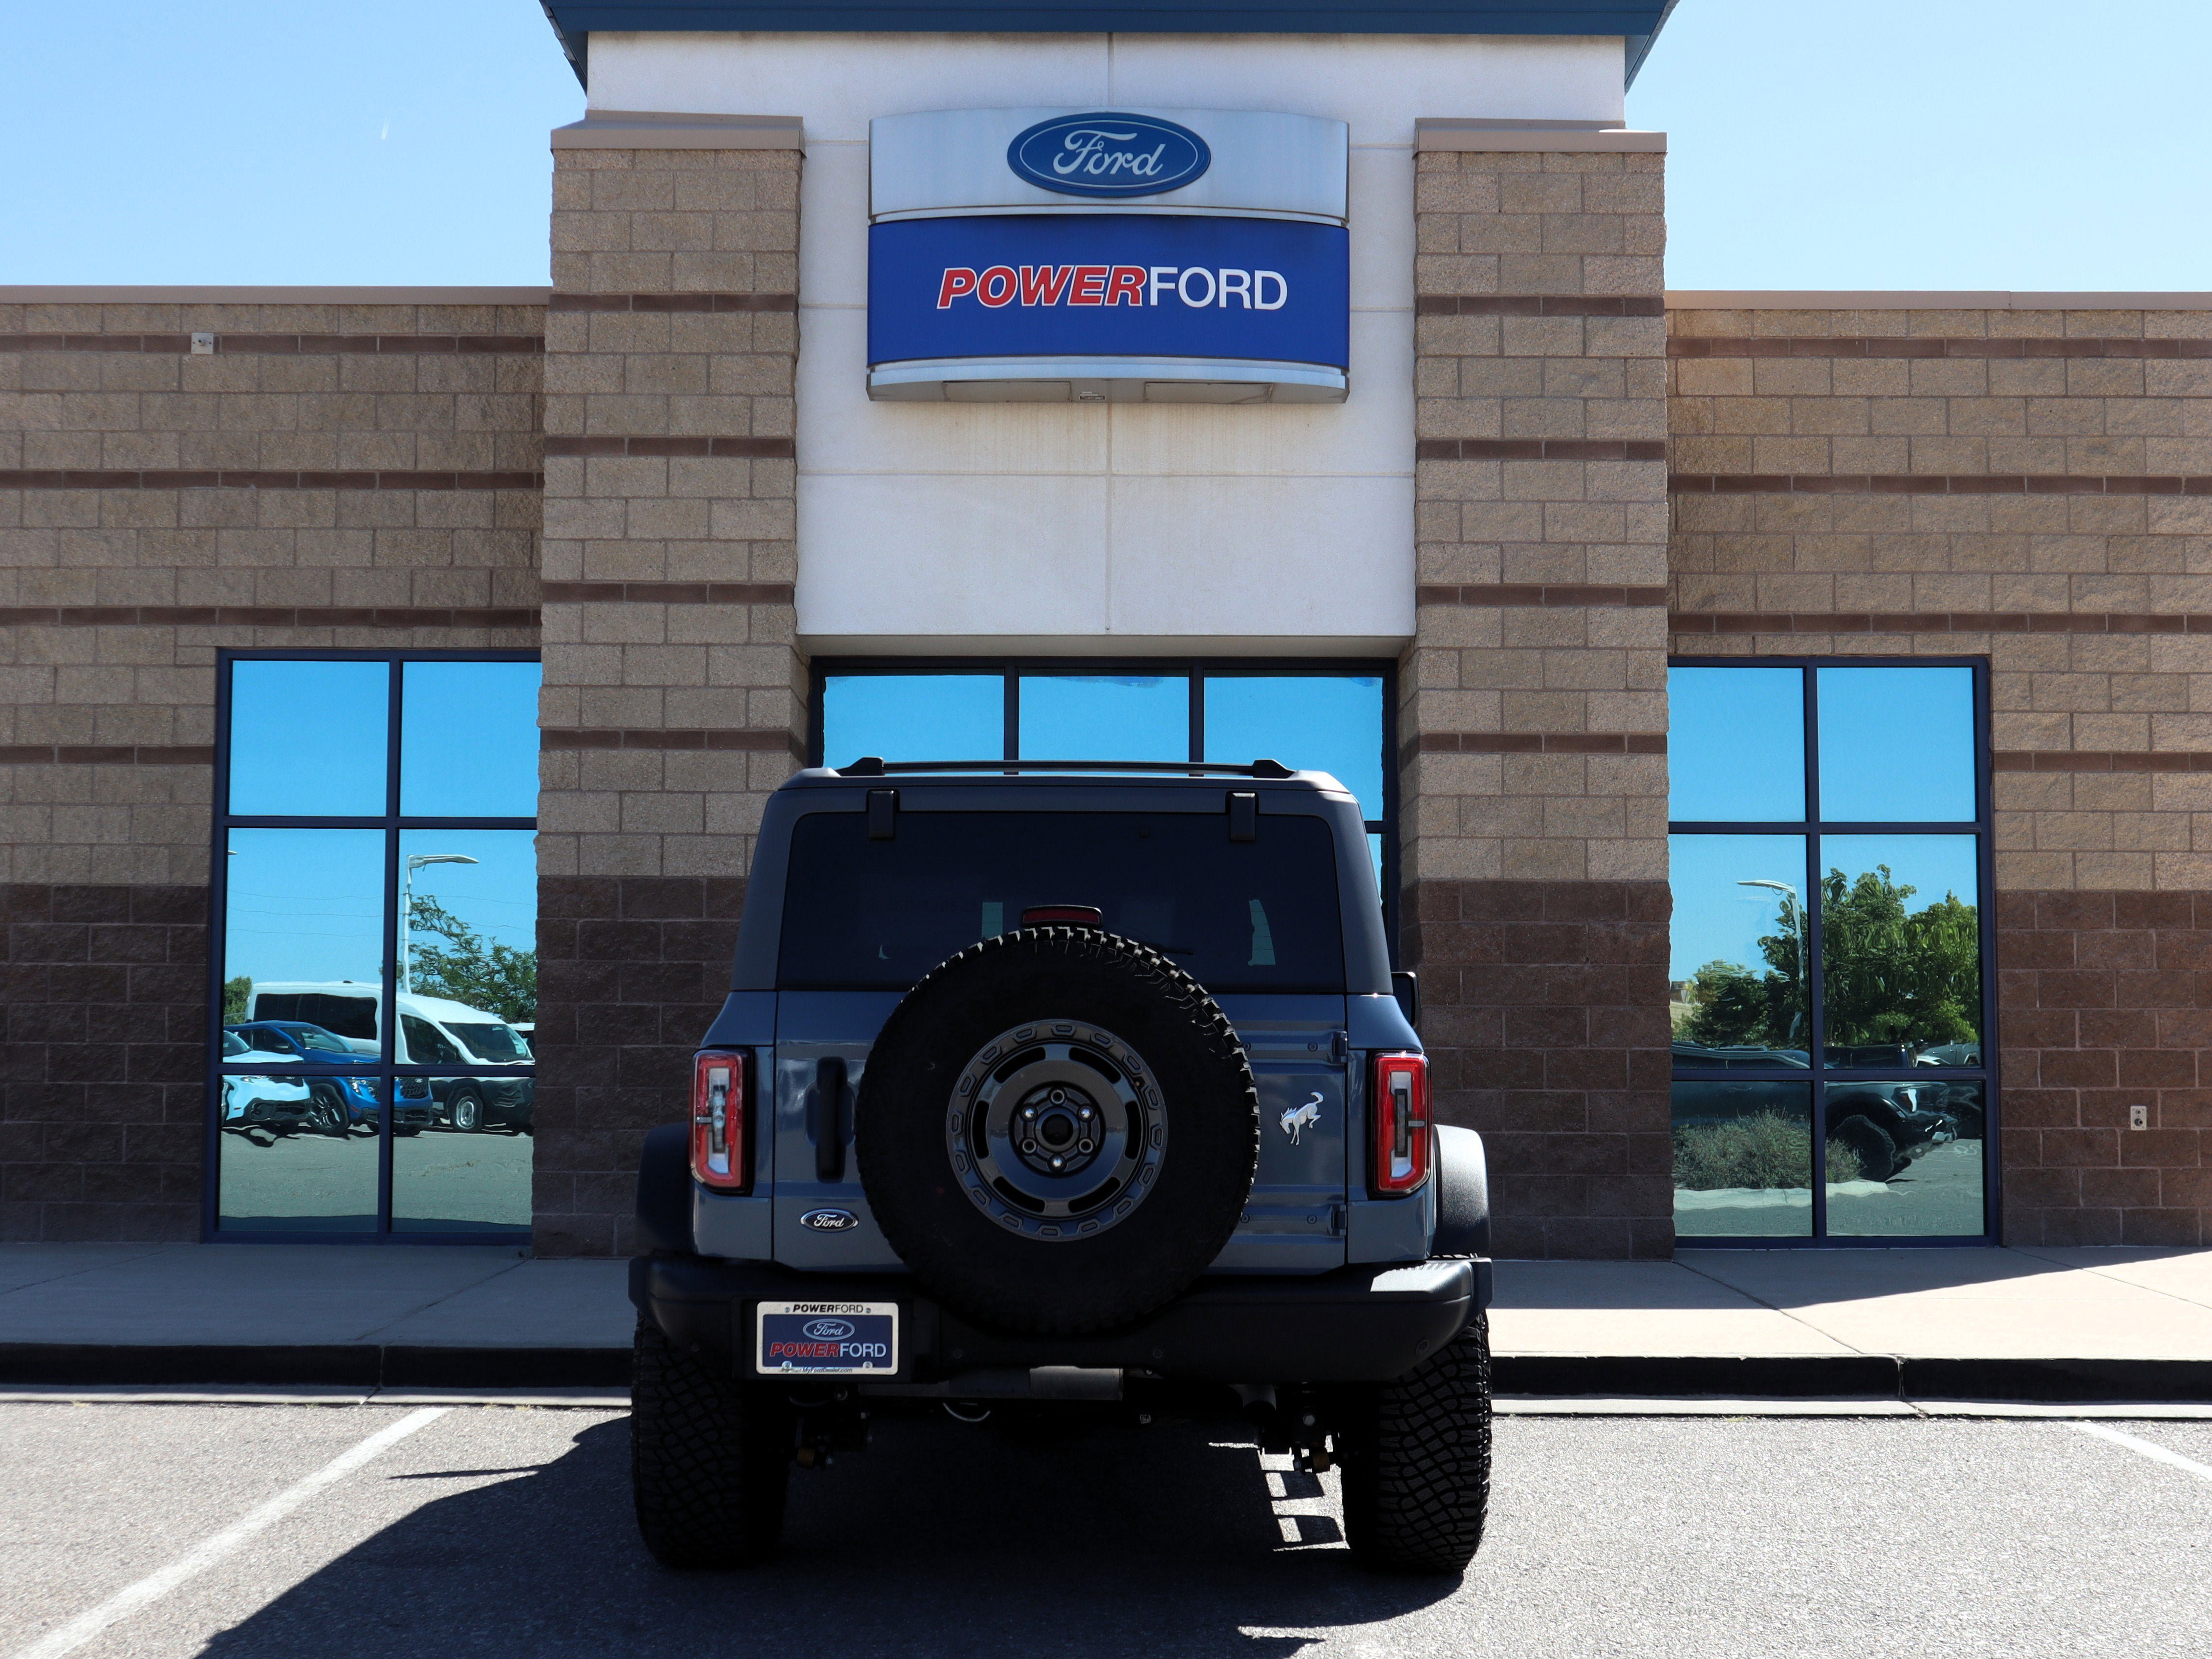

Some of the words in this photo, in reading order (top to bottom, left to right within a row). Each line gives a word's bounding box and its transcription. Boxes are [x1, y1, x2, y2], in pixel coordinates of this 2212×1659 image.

[1054, 129, 1166, 176] Ford
[936, 264, 1288, 310] POWERFORD
[813, 1214, 845, 1227] Ford
[793, 1304, 864, 1313] POWERFORD
[814, 1323, 844, 1335] Ford
[769, 1343, 887, 1357] POWERFORD
